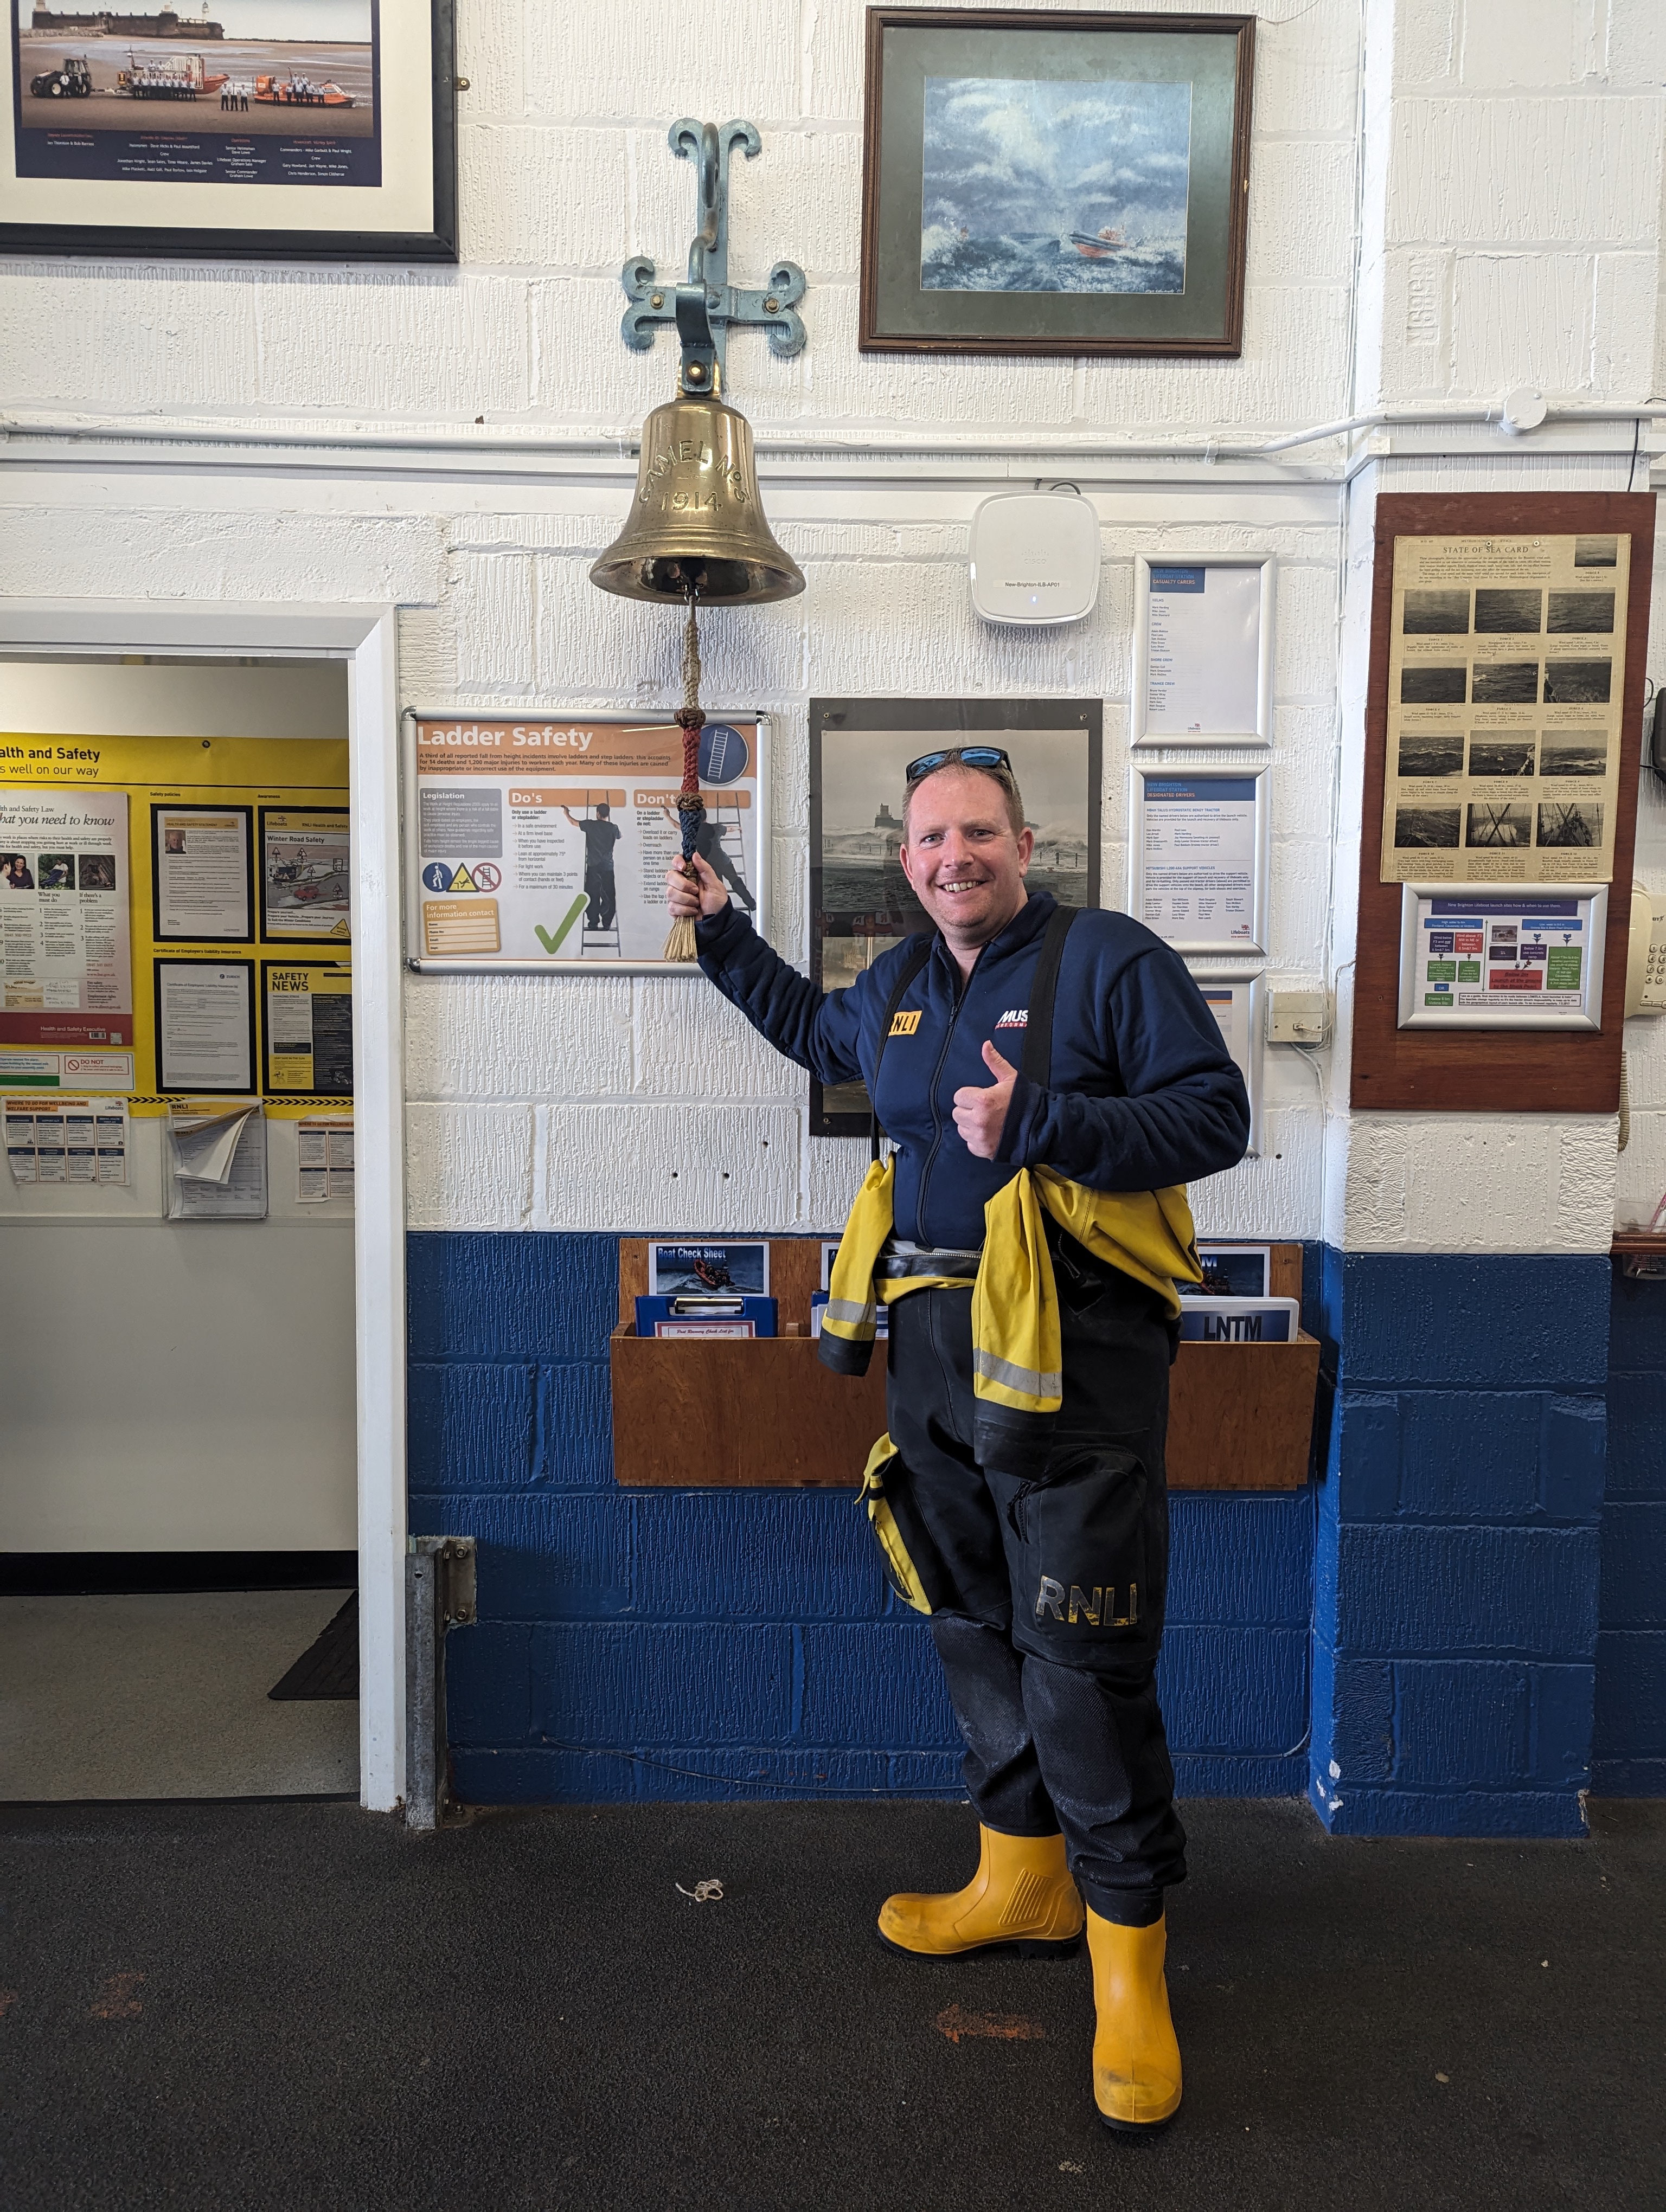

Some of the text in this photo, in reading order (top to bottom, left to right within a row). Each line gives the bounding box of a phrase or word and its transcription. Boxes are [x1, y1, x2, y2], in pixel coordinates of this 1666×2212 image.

[639, 440, 709, 503] CAMEL
[734, 487, 752, 504] 3
[661, 491, 723, 511] 1914
[418, 725, 593, 751] Ladder Safety
[0, 746, 100, 763] alth and Safety
[9, 763, 33, 774] well
[76, 767, 98, 778] way
[512, 793, 542, 803] Do's
[637, 794, 676, 805] Don't
[22, 805, 39, 813] Safety
[0, 813, 114, 826] hat you need to know
[272, 981, 309, 991] NEWS
[889, 1014, 917, 1032] NLI
[997, 1010, 1029, 1024] MUS
[658, 1248, 726, 1258] Boat Check Sheet
[1204, 1316, 1262, 1341] LNTM
[1036, 1575, 1137, 1626] RNLI
